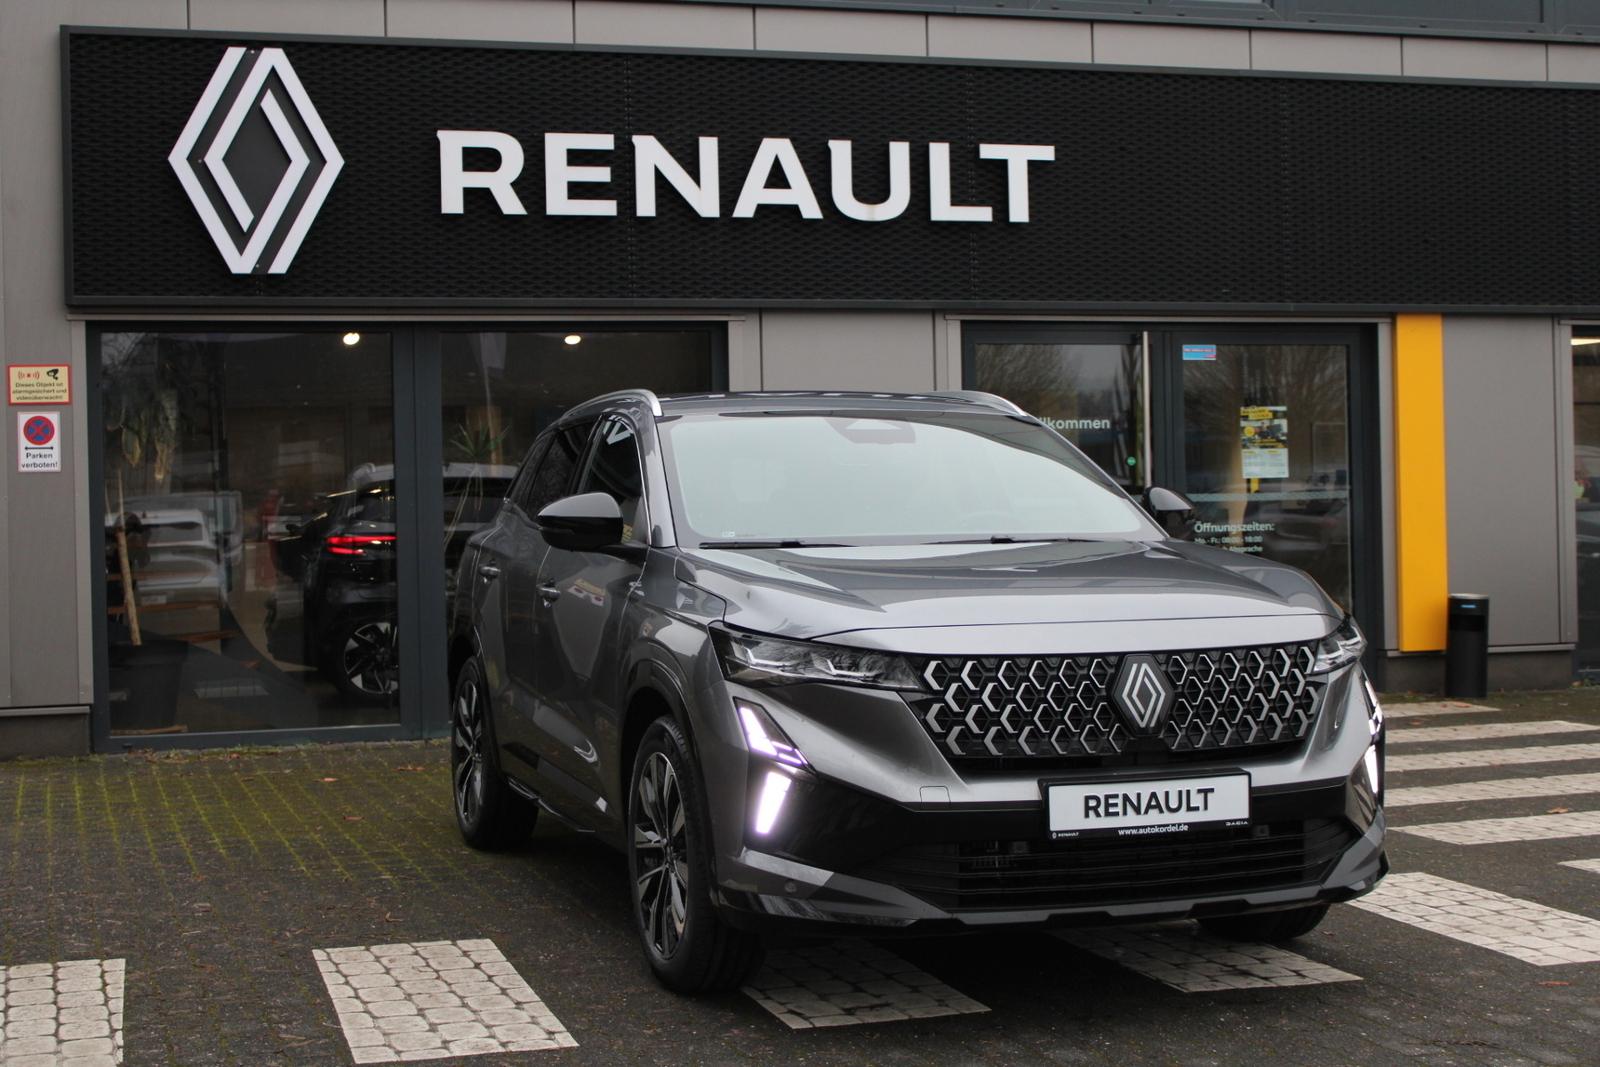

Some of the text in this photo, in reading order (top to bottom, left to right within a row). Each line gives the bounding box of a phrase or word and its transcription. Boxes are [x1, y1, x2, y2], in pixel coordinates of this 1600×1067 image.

[436, 129, 1056, 223] RENAULT
[1194, 520, 1275, 534] Öffnungszeiten:
[1084, 787, 1215, 818] RENAULT
[1118, 823, 1189, 836] www.autokordel.de
